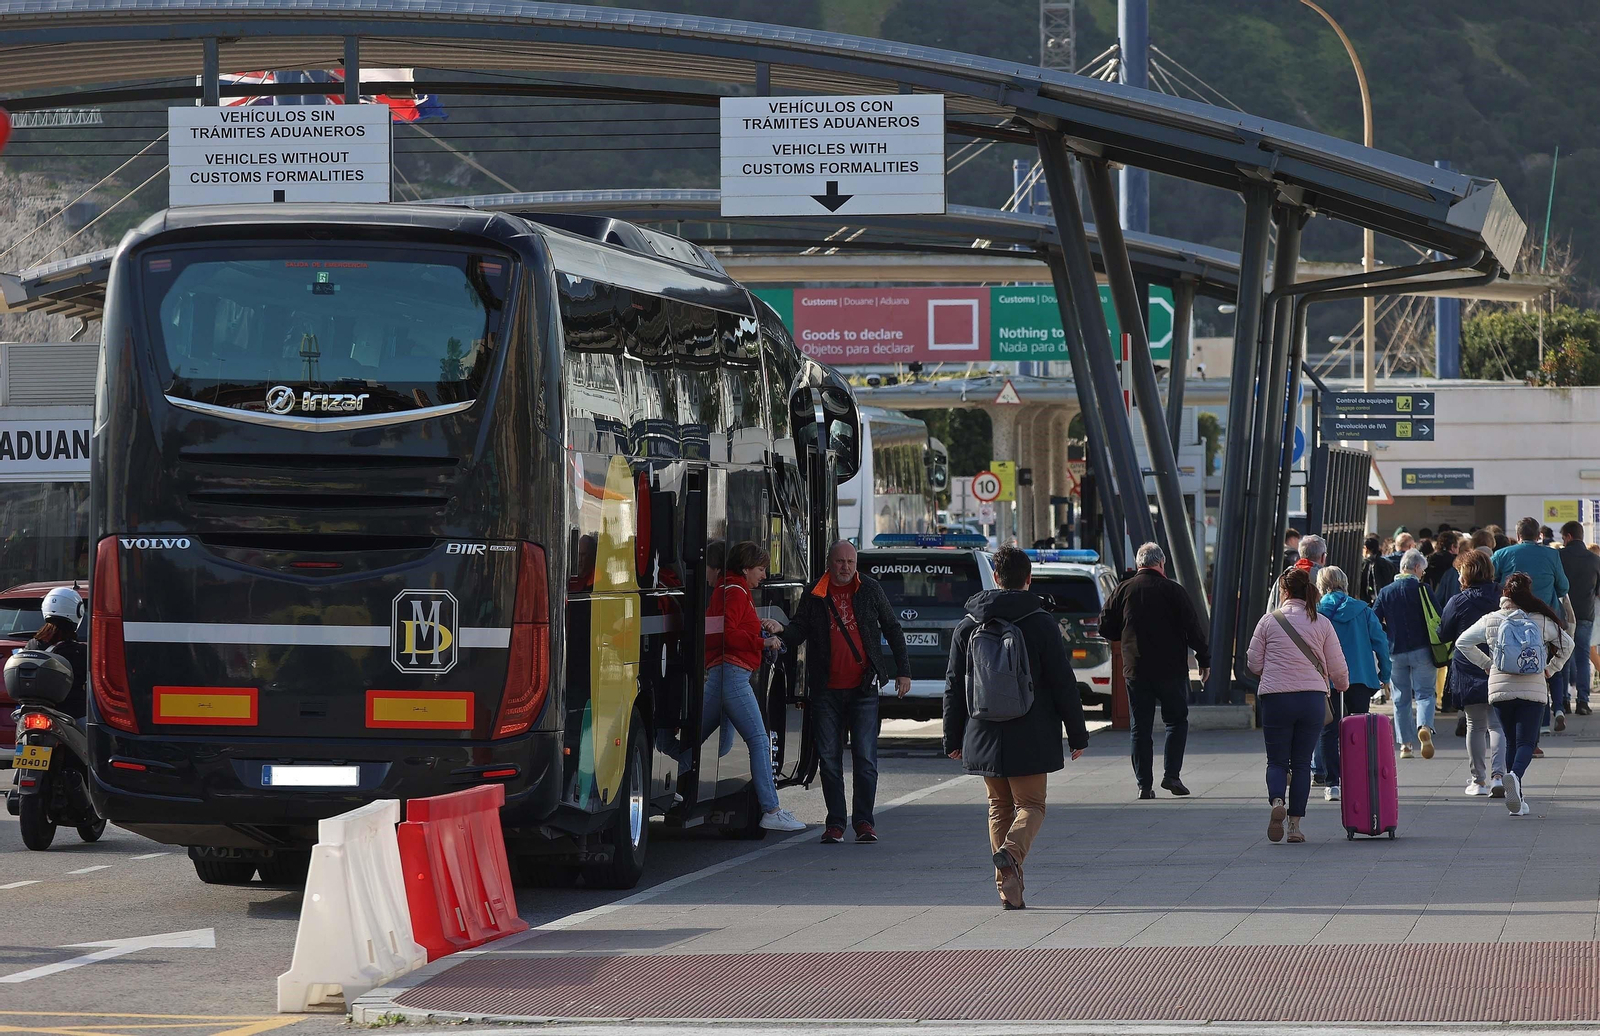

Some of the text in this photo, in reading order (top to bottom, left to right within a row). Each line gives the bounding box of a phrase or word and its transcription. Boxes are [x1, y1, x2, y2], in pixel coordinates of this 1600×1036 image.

[769, 100, 893, 114] VEHÍCULOS CON
[220, 110, 335, 122] VEHÍCULOS SIN
[743, 116, 920, 130] TRÁMITES ADUANEROS
[190, 126, 365, 138] TRÁMITES ADUANEROS
[772, 143, 887, 155] VEHICLES WITH
[205, 152, 349, 165] VEHICLES WITHOUT
[742, 161, 919, 175] CUSTOMS FORMALITIES
[190, 170, 364, 183] CUSTOMS FORMALITIES
[802, 297, 910, 306] Customs Douane Aduana
[802, 329, 903, 340] Goods to declare
[999, 327, 1064, 340] Nothing to
[803, 342, 915, 357] Objetos para declarar
[1000, 342, 1028, 352] Nada
[1031, 343, 1055, 354] para
[978, 480, 996, 493] 10
[120, 538, 190, 550] VOLVO
[446, 543, 486, 555] B11R
[871, 565, 953, 574] GUARDIA CIVIL
[907, 635, 937, 644] 9754 N
[16, 758, 40, 766] 7040
[194, 846, 274, 858] VOLVO
